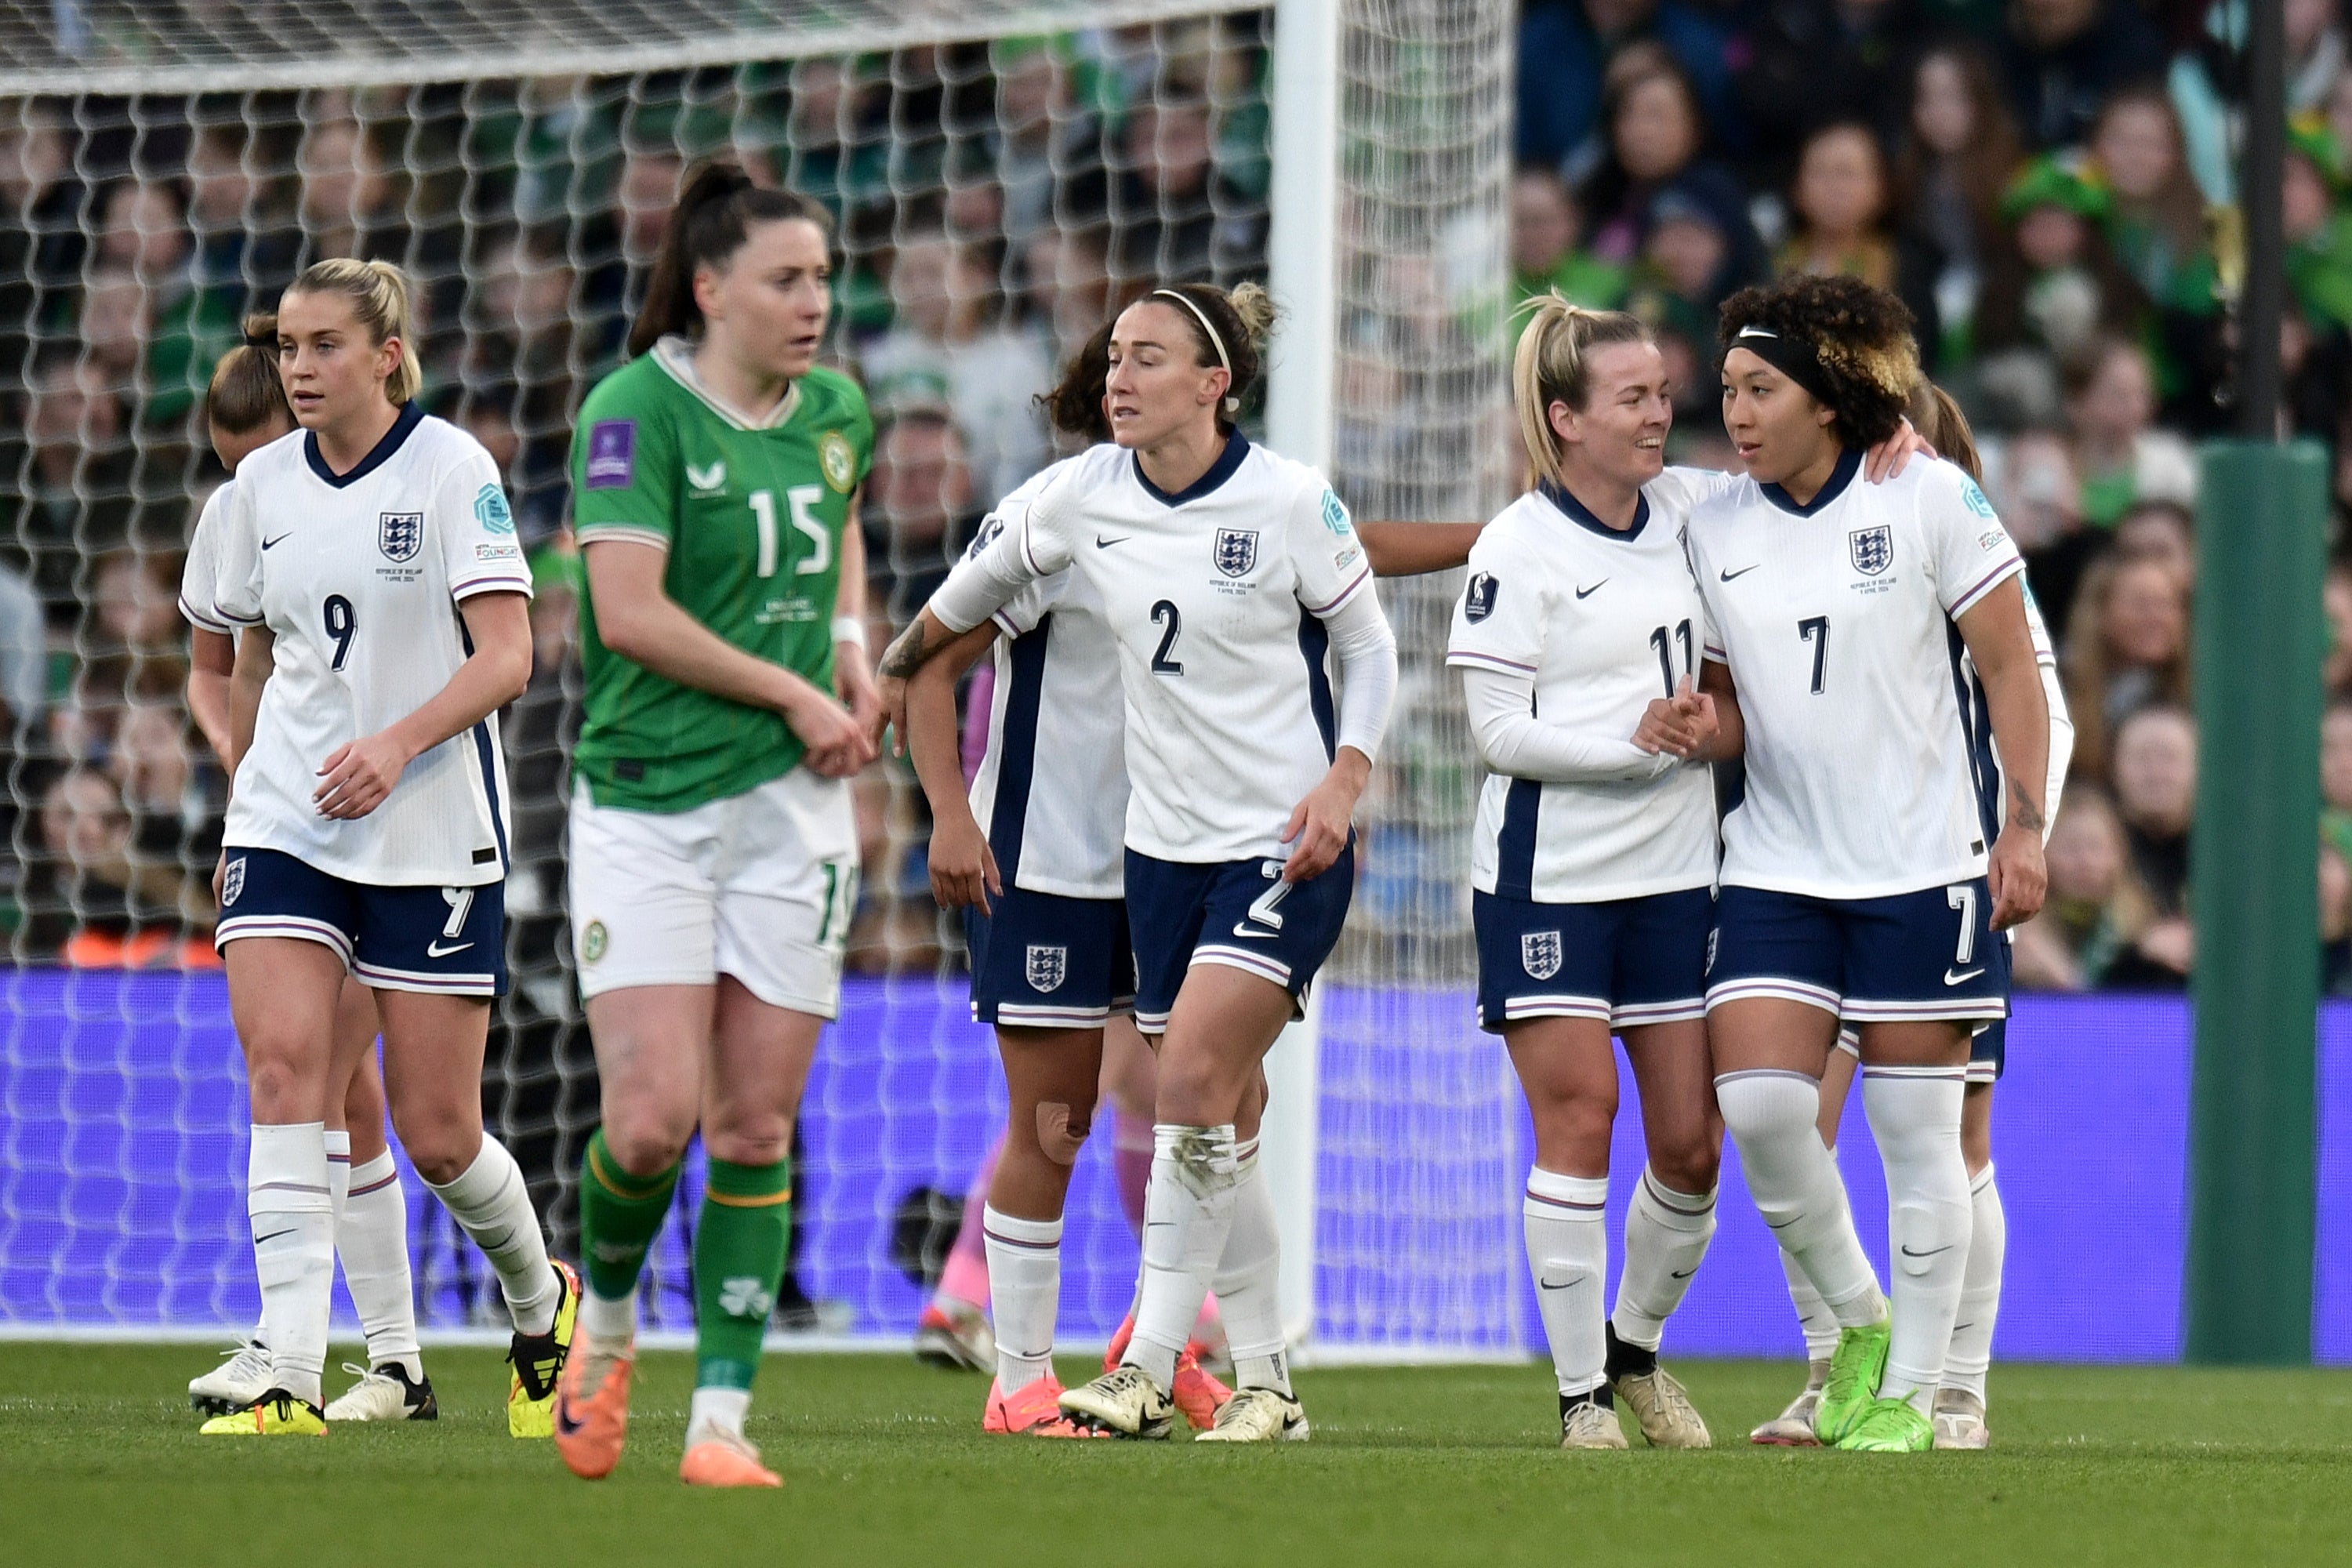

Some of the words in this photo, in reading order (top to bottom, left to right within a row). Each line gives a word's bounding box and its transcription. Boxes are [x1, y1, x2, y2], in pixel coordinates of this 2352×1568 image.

[748, 484, 833, 578] 15
[324, 593, 358, 673] 9
[1150, 600, 1184, 676] 2
[1650, 618, 1693, 699] 11
[1797, 615, 1831, 695] 7
[441, 885, 475, 938] 9
[1248, 859, 1293, 930] 2
[1947, 886, 1976, 964] 7
